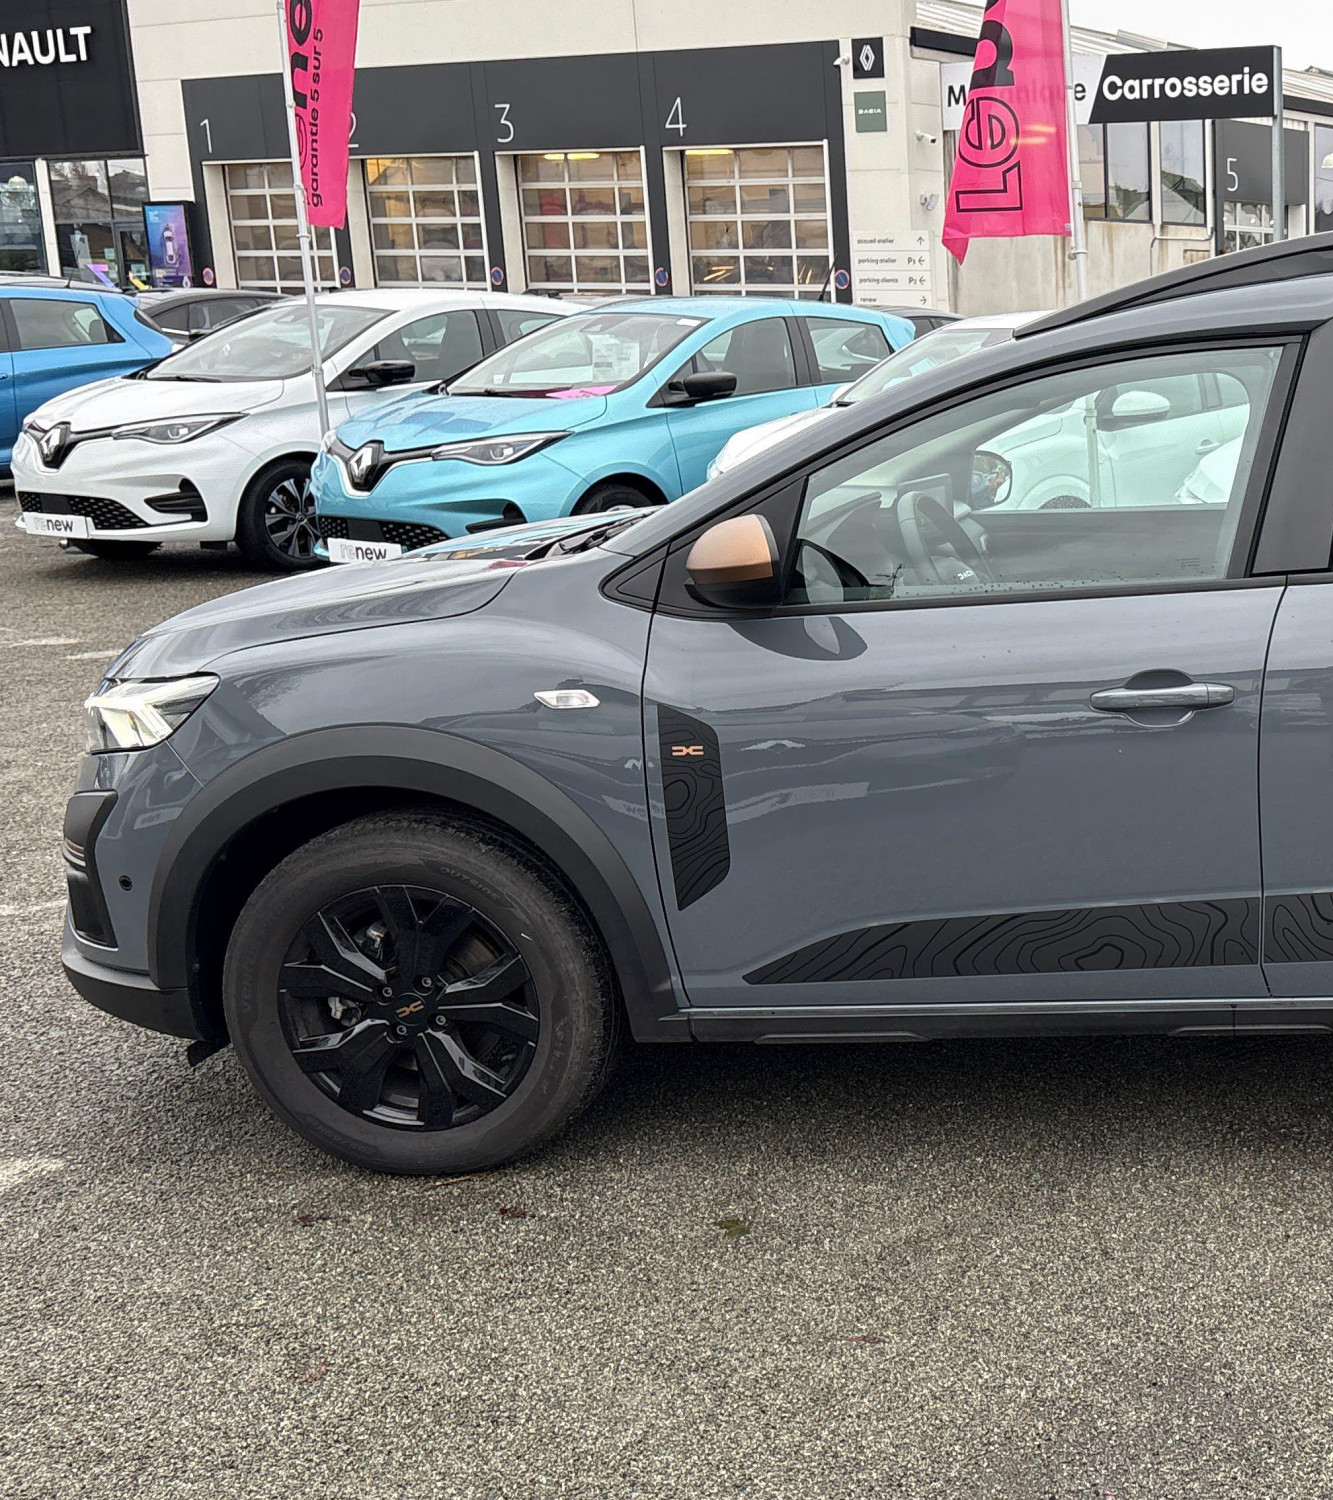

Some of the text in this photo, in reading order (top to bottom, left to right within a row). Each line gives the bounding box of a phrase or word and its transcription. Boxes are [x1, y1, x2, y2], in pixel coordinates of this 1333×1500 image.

[1102, 66, 1269, 101] Carrosserie
[308, 28, 324, 208] garantie 5 sur 5
[494, 103, 515, 143] 3
[665, 96, 687, 137] 4
[200, 118, 213, 153] 1
[1226, 157, 1239, 192] 5
[340, 544, 387, 561] renew
